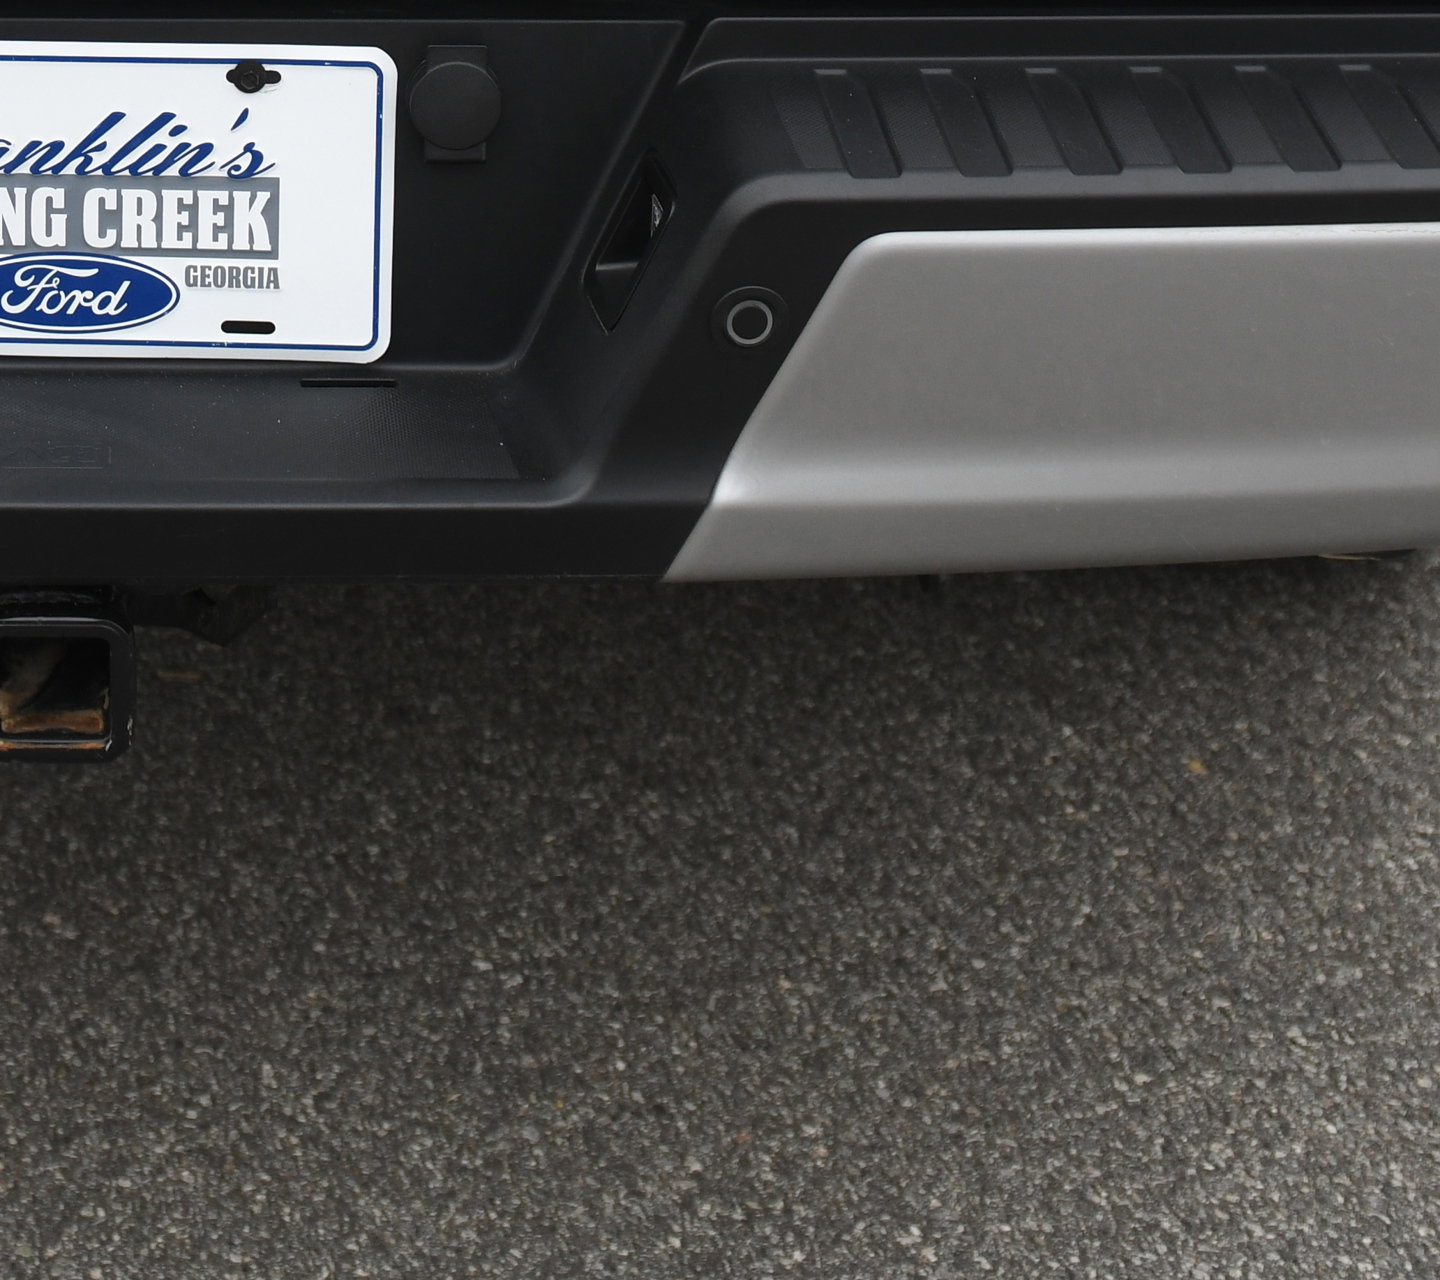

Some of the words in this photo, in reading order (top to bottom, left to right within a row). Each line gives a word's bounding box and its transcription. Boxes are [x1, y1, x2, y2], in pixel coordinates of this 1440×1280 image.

[82, 187, 273, 252] CREEK
[0, 265, 129, 316] Ford
[184, 264, 280, 290] GEORGIA
